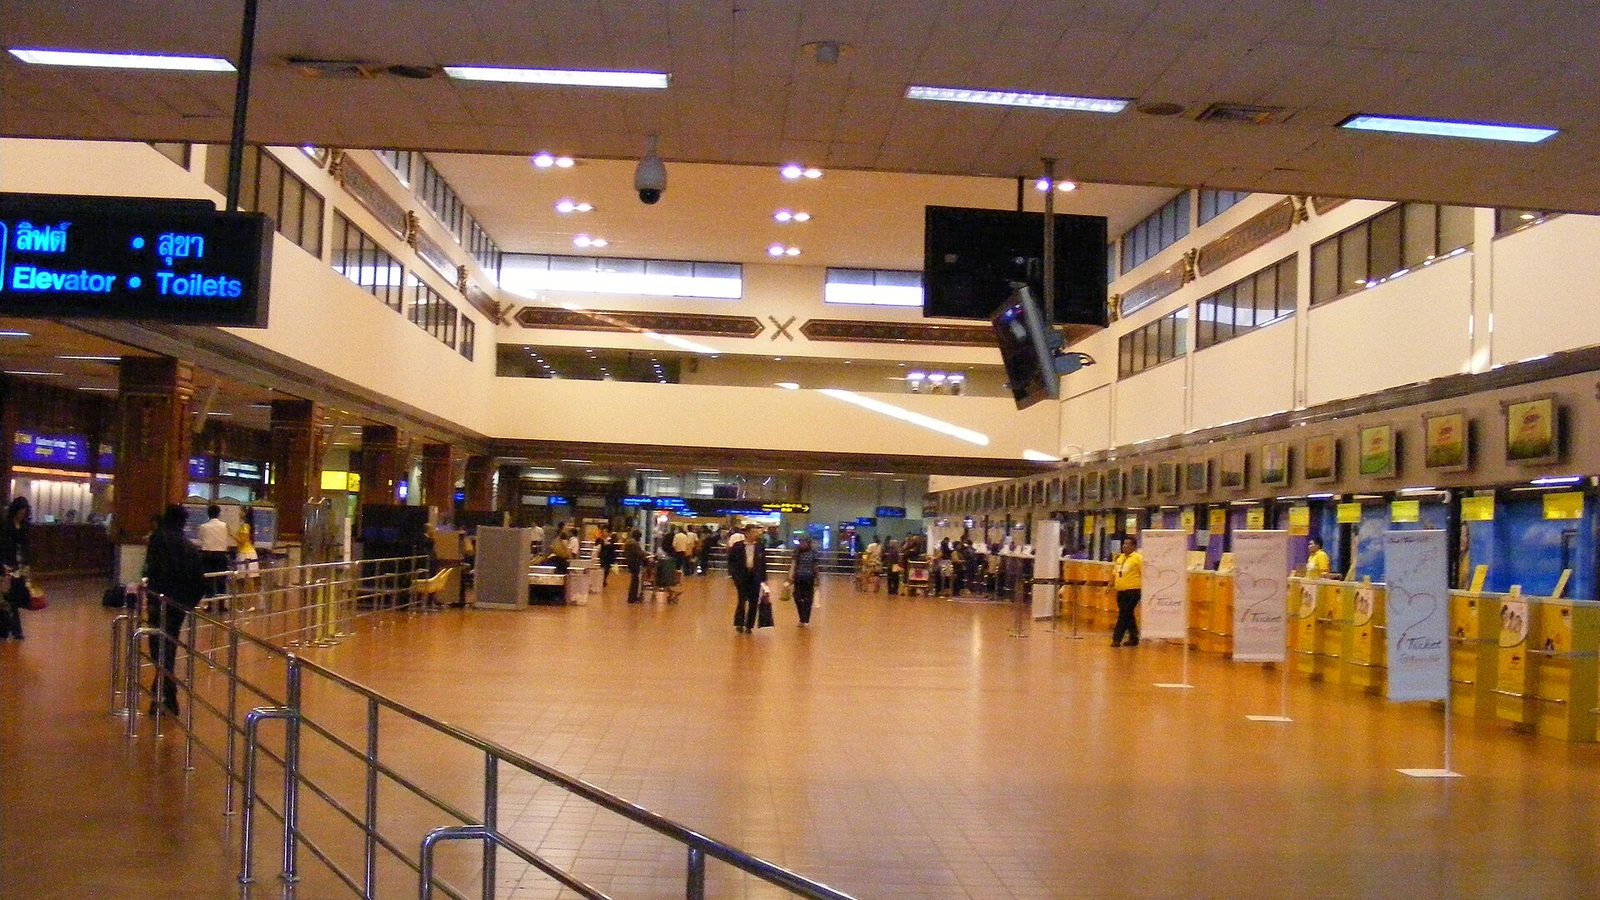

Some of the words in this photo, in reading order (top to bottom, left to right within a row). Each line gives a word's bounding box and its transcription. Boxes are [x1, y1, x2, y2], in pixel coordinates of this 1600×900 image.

[16, 222, 71, 252] ลิฟต์
[159, 234, 204, 266] สุขา
[12, 266, 116, 292] Elevator
[157, 272, 241, 297] Toilets
[1406, 636, 1441, 650] Ticket
